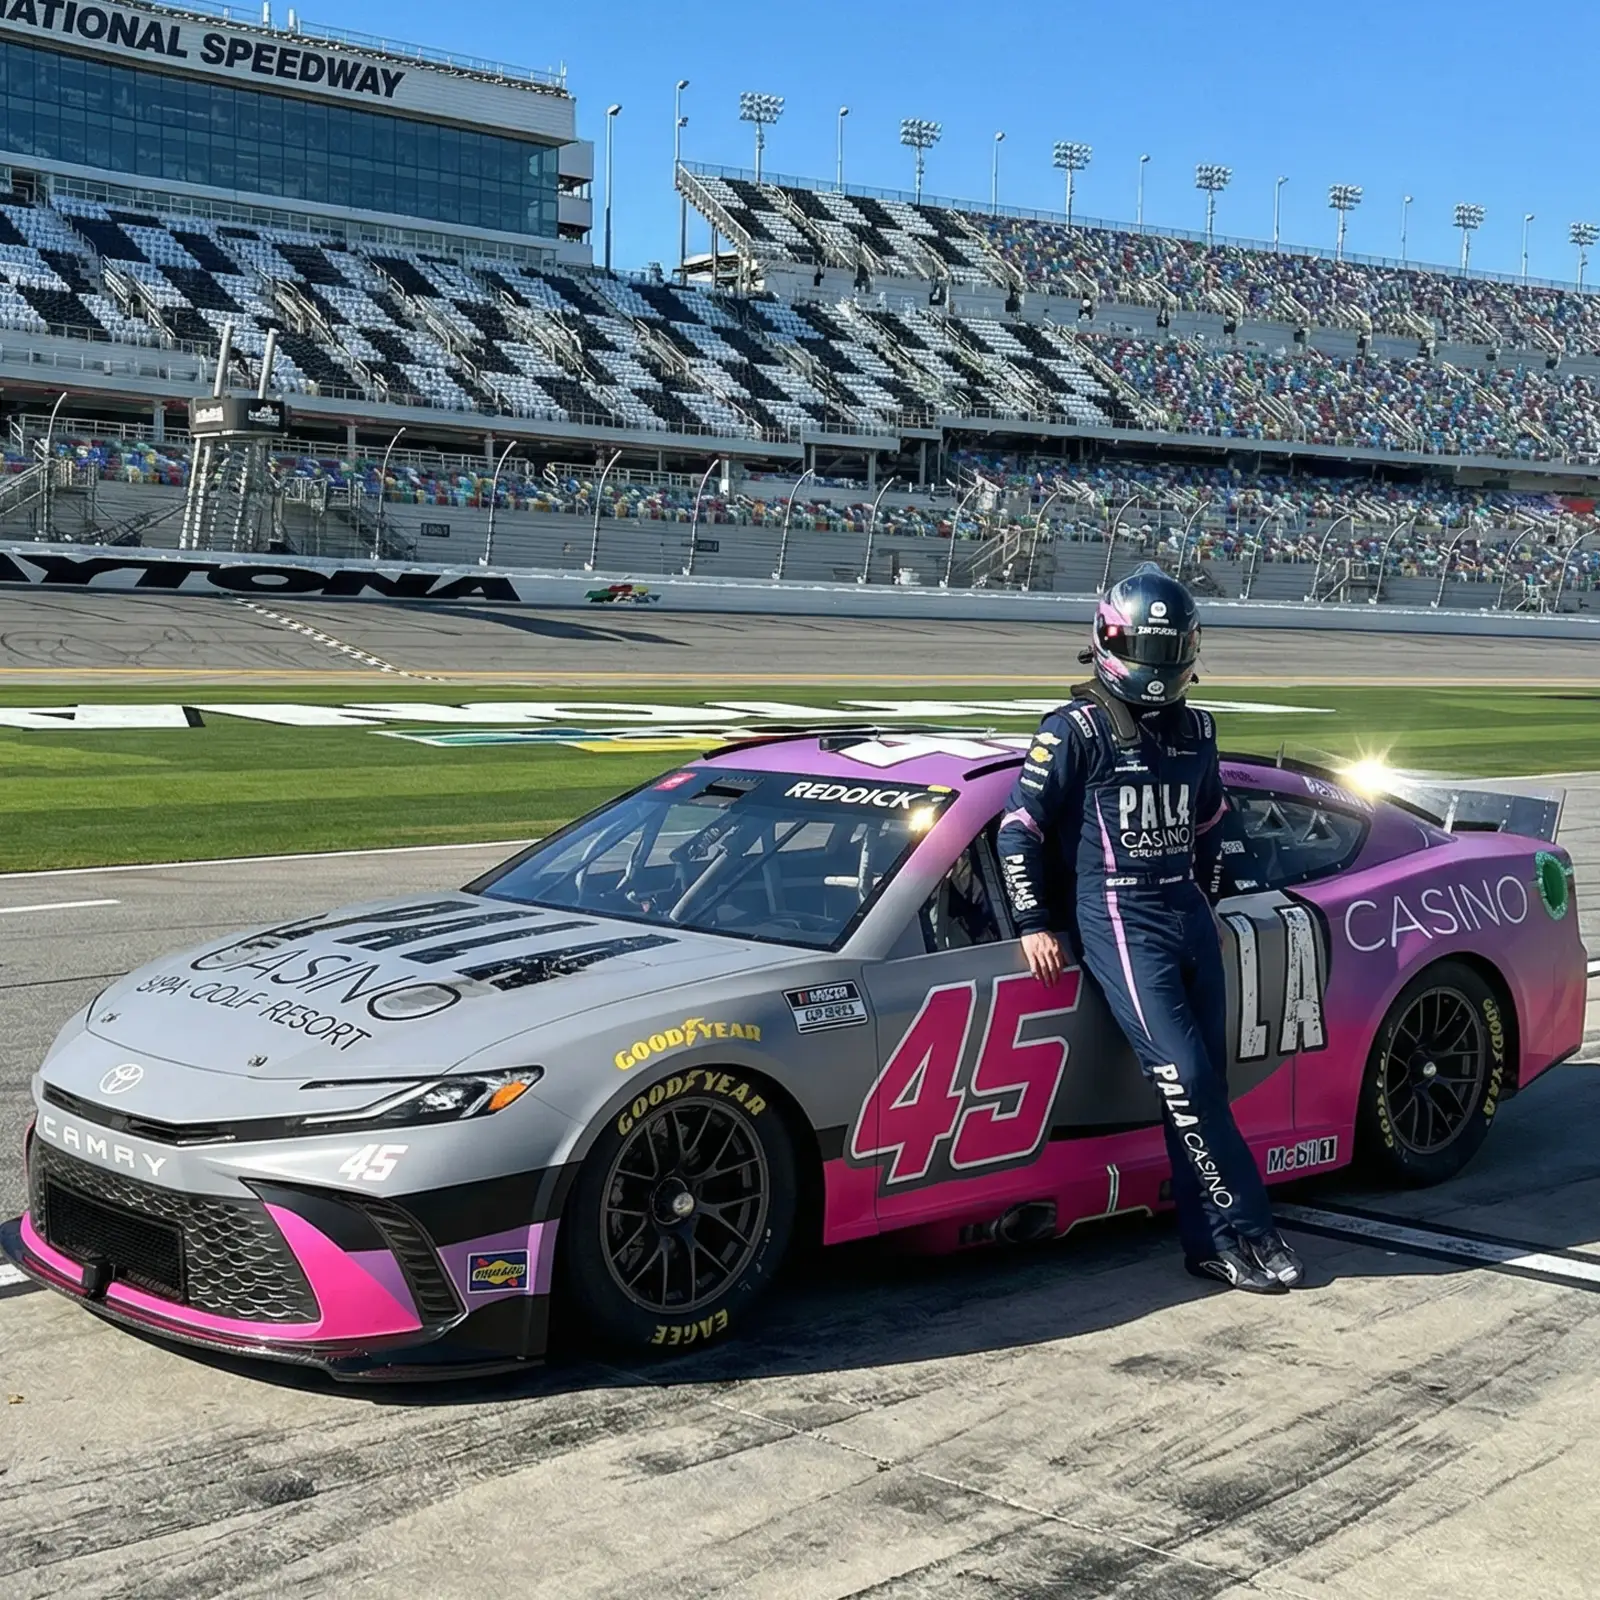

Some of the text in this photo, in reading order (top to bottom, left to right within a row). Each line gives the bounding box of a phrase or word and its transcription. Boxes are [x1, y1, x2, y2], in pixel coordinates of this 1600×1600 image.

[0, 0, 405, 98] ATIONAL SPEEDWAY
[0, 553, 521, 602] YTONA
[1119, 784, 1190, 830] PALA
[1120, 827, 1190, 848] CASINO
[1345, 876, 1528, 951] CASINO
[190, 914, 462, 1021] CASINO
[258, 1000, 372, 1050] RESORT
[614, 1017, 761, 1071] GOODYEAR
[617, 1069, 767, 1136] GOODYEAR
[852, 965, 1083, 1185] 45
[43, 1115, 167, 1177] CAMRY
[338, 1144, 409, 1181] 45
[1153, 1064, 1233, 1208] PALA CASINO
